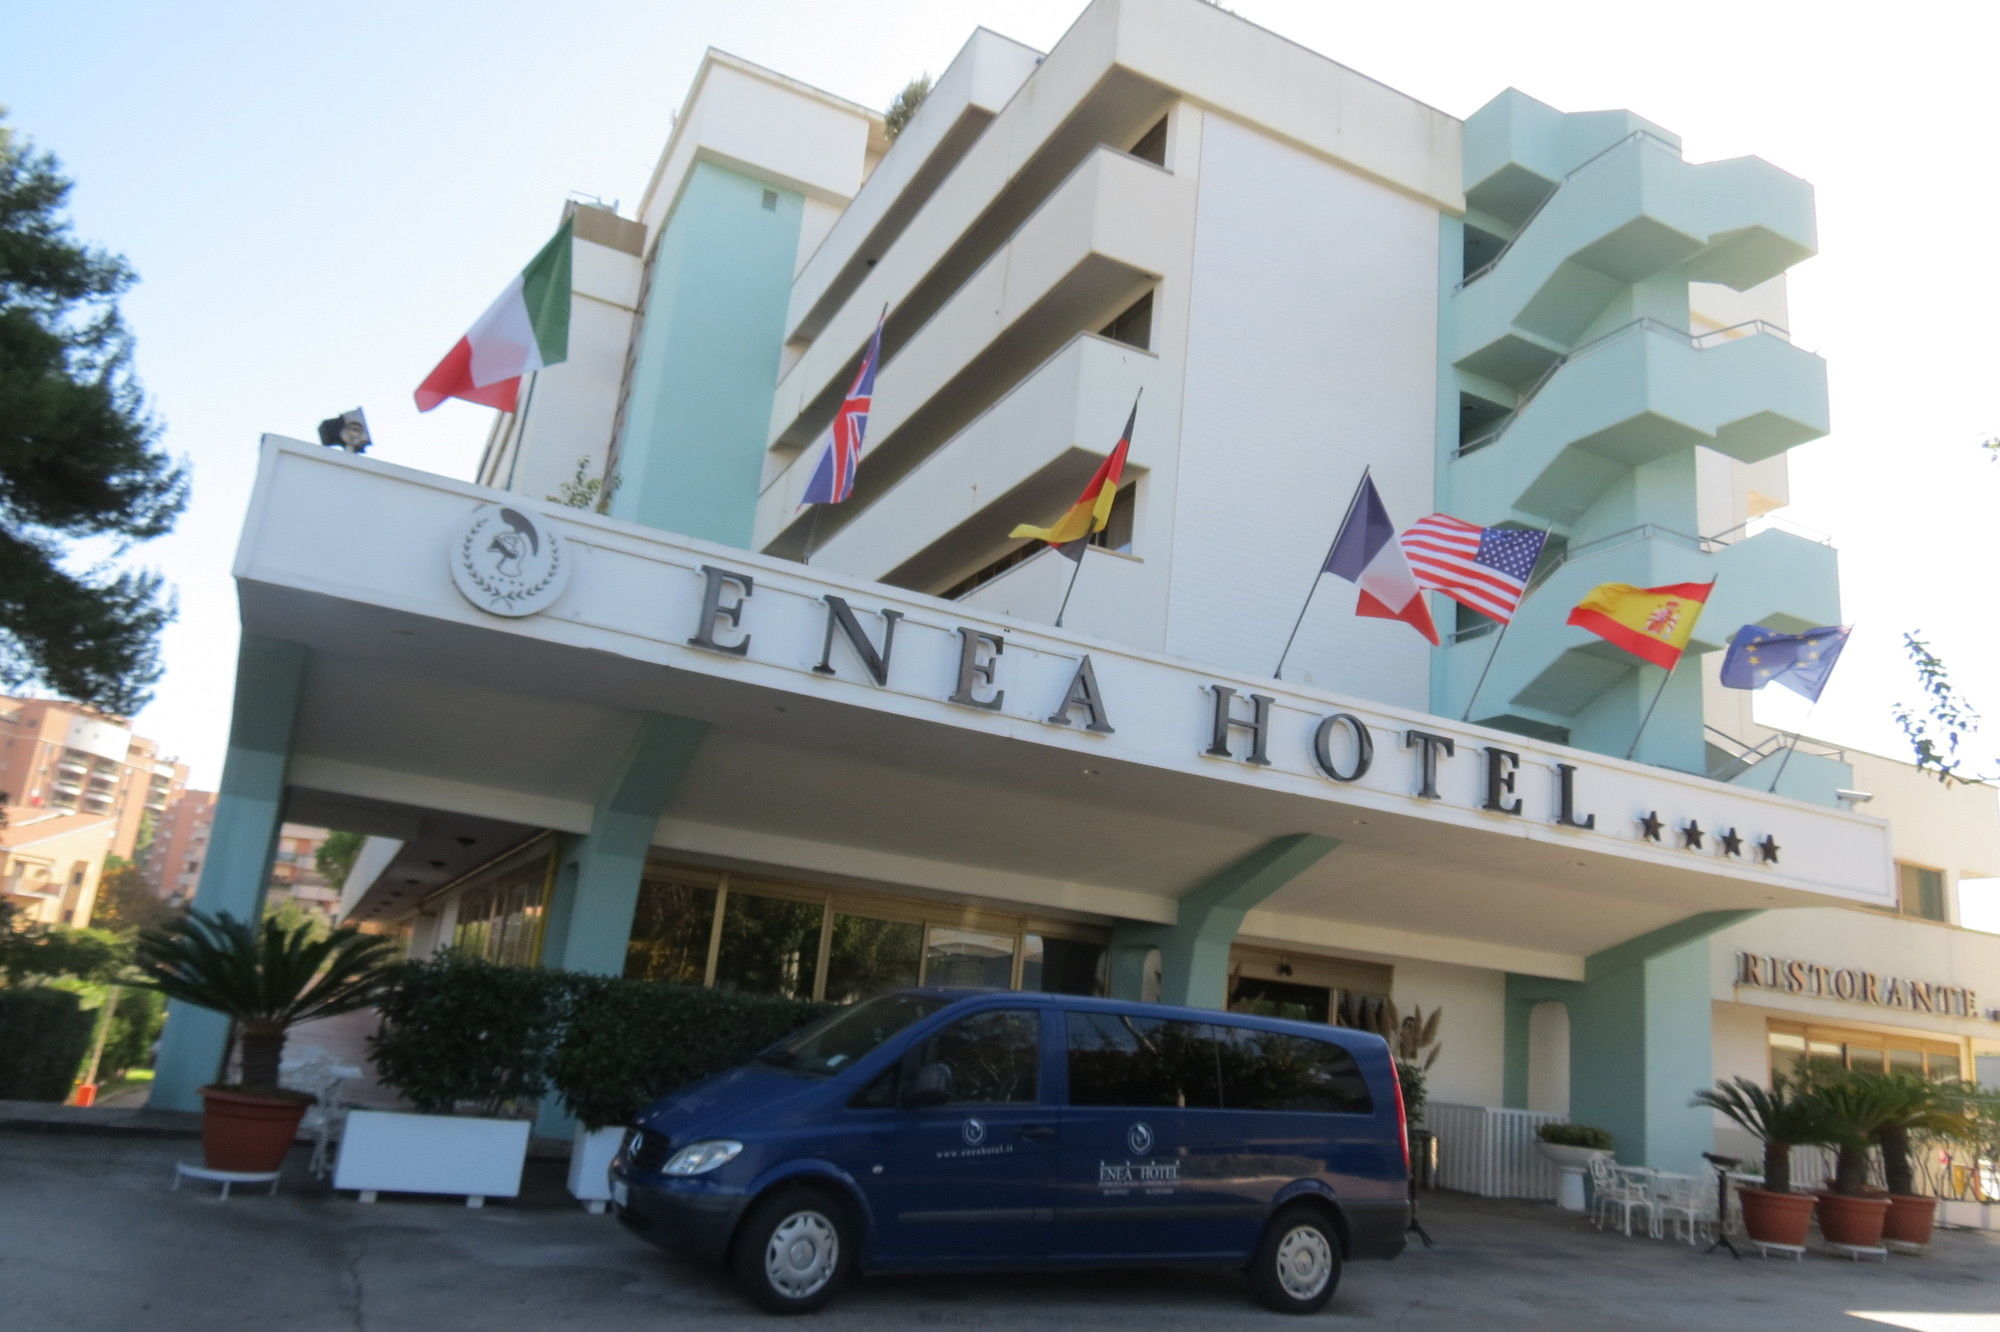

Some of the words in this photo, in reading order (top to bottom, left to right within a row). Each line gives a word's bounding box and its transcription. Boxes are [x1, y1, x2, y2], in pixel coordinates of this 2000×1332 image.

[688, 564, 1115, 734] ENEA
[1205, 683, 1595, 831] HOTEL
[1735, 951, 1979, 1018] RISTORANTE
[1099, 1166, 1132, 1181] ENEA
[1140, 1165, 1180, 1180] HOTEL
